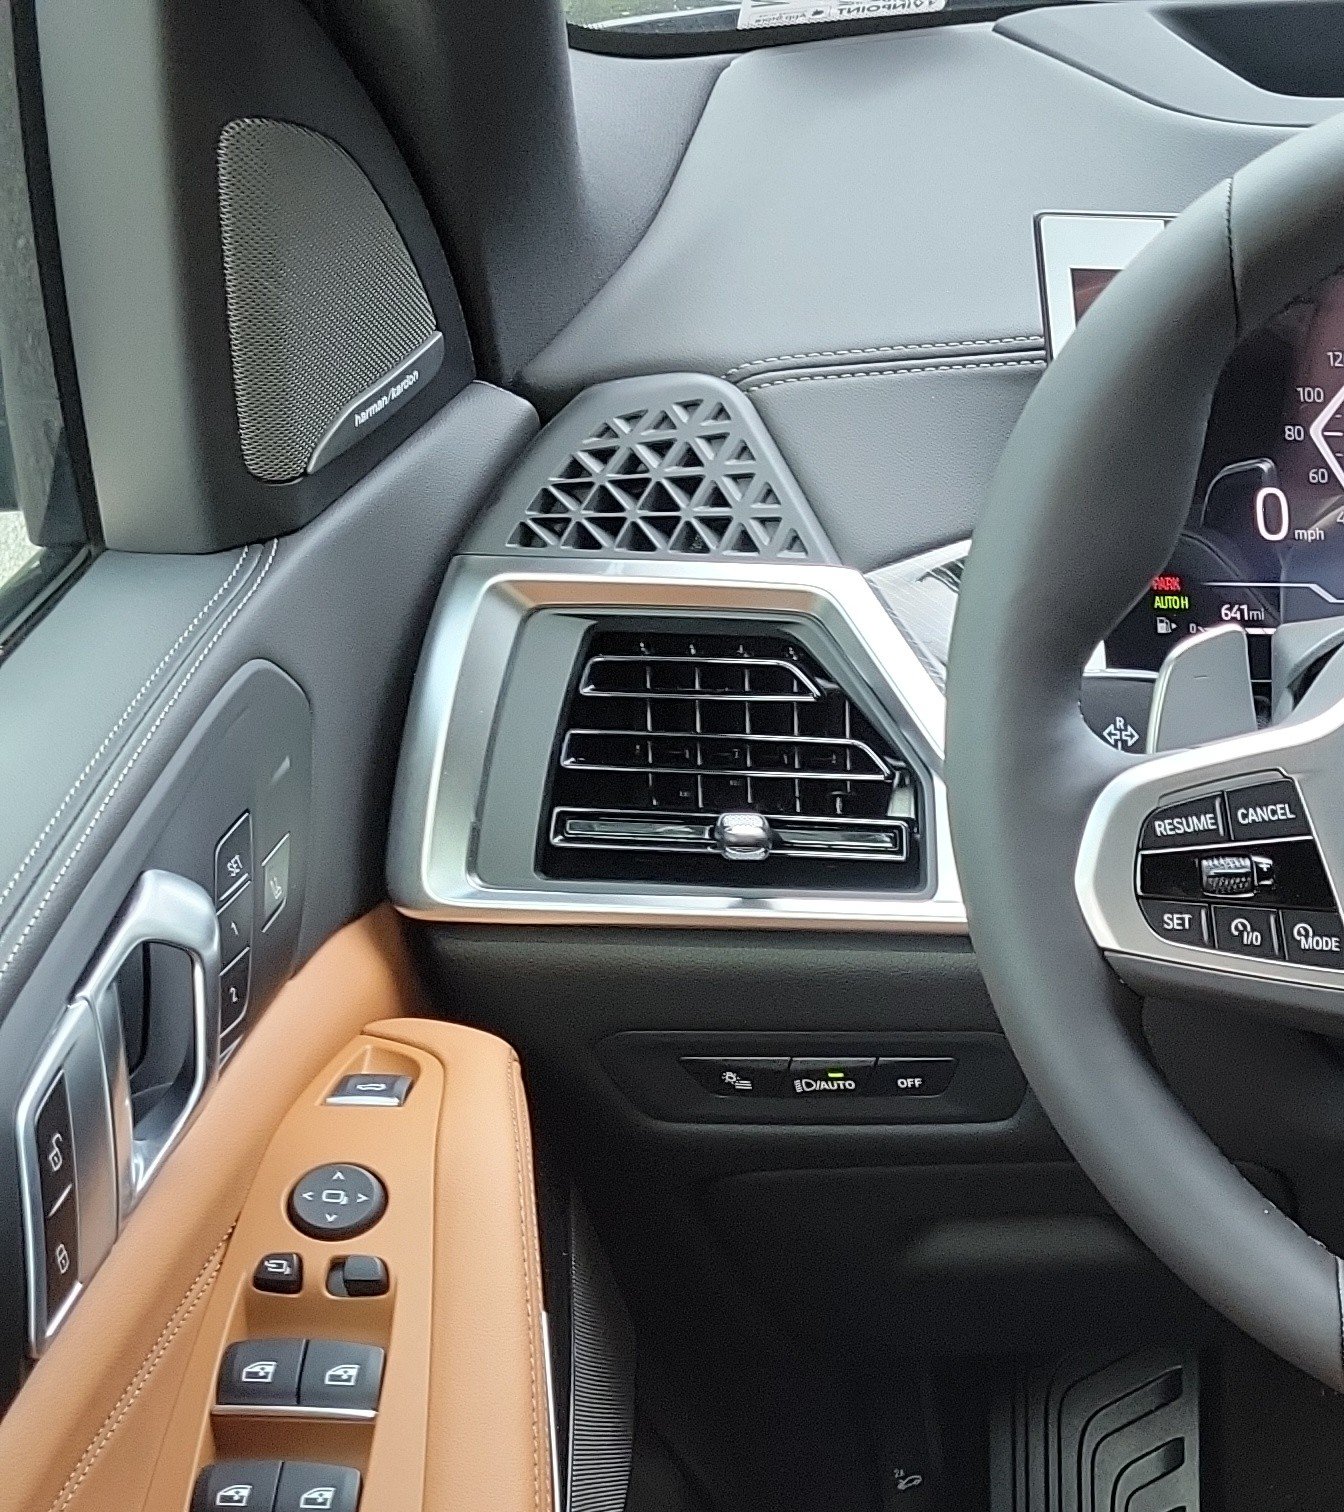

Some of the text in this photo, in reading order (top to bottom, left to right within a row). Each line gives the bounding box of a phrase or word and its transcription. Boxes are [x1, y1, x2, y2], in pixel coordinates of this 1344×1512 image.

[1296, 387, 1324, 402] 100
[1284, 426, 1304, 440] 80
[1308, 468, 1328, 483] 60
[1255, 487, 1290, 540] 0
[1294, 527, 1325, 541] mph
[1154, 595, 1180, 609] AUTO
[1115, 716, 1125, 729] R
[1154, 803, 1297, 838] RESUME CANCEL
[226, 854, 243, 877] SET
[230, 922, 239, 936] 1
[1163, 912, 1192, 931] SET
[1300, 935, 1341, 953] MODE
[229, 987, 239, 1004] 2
[896, 1077, 924, 1089] OFF
